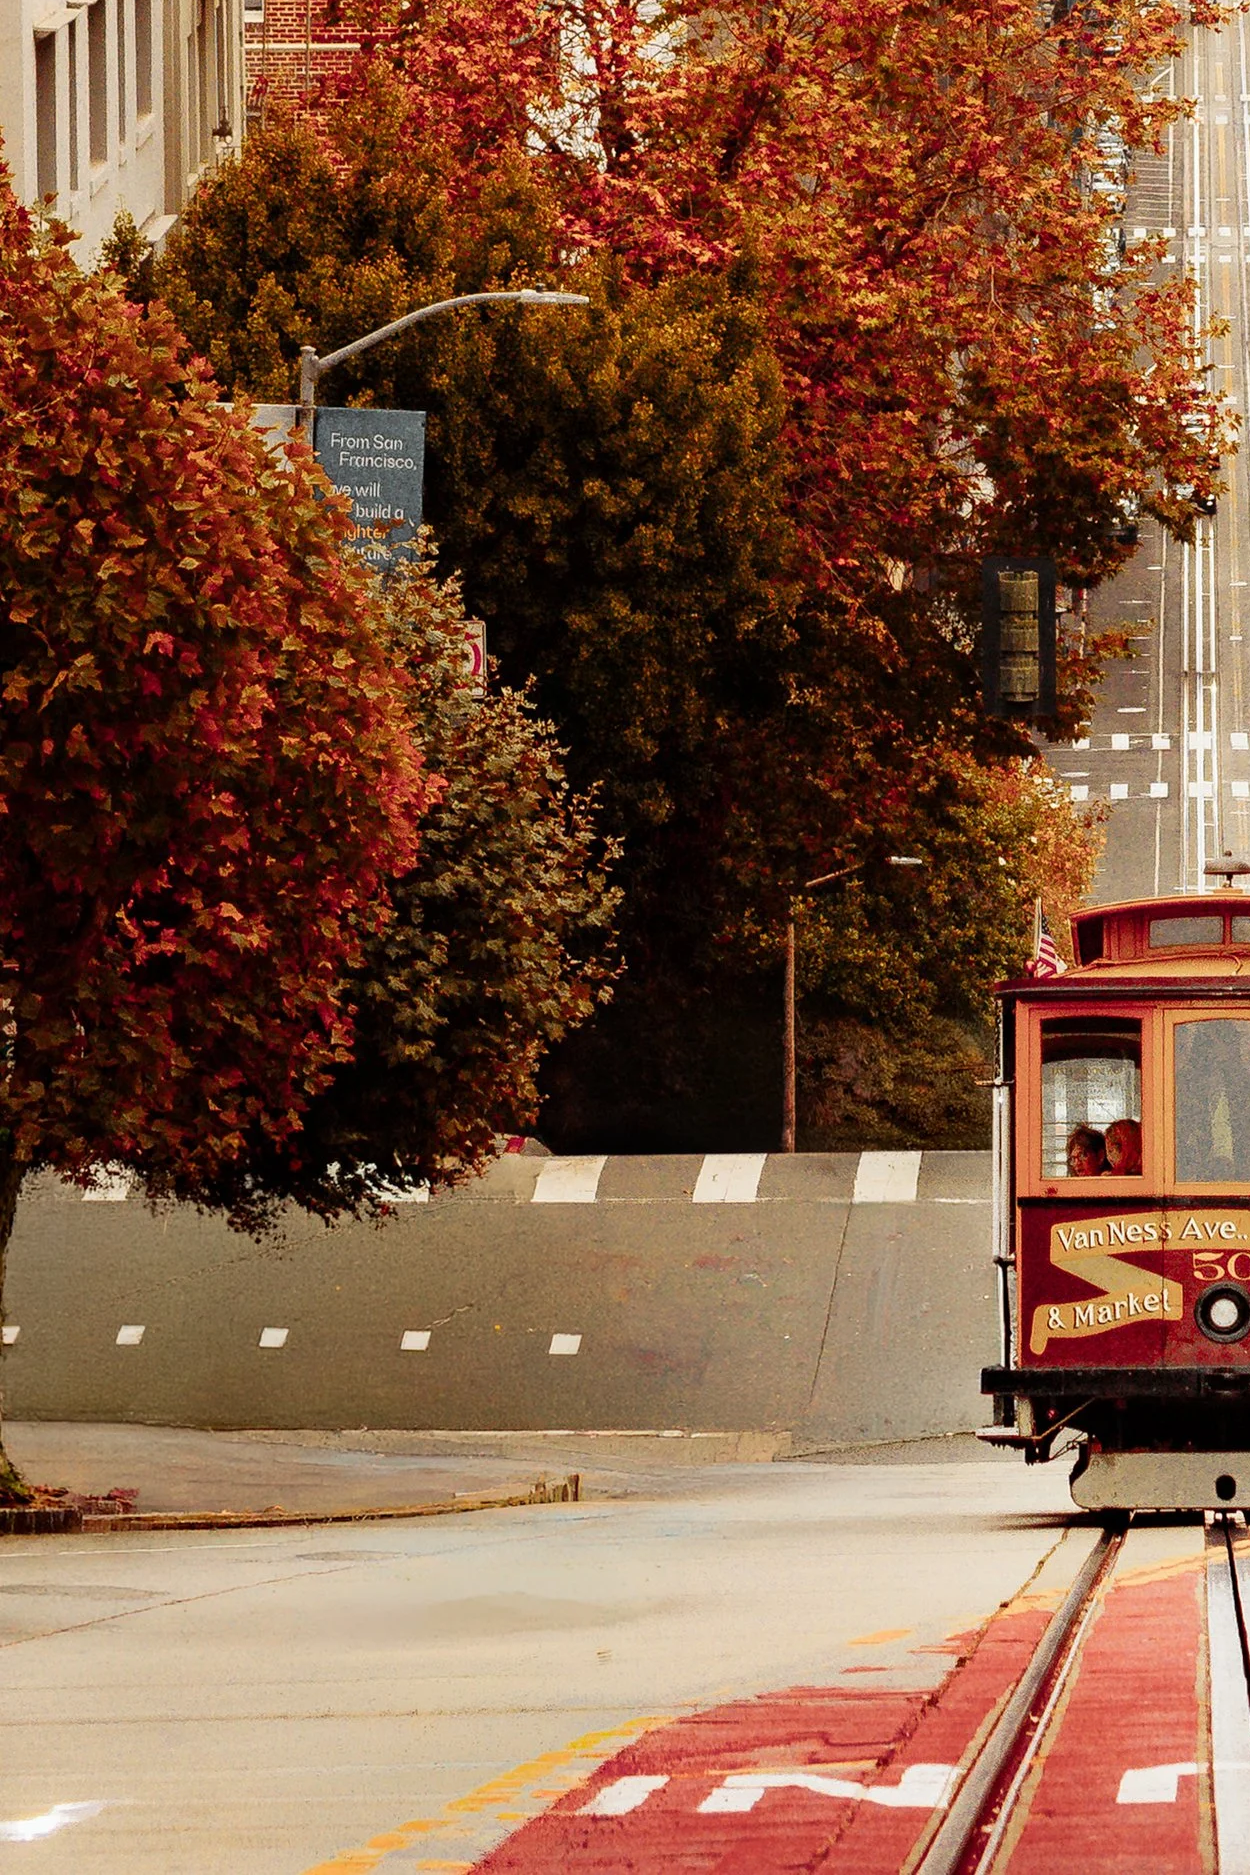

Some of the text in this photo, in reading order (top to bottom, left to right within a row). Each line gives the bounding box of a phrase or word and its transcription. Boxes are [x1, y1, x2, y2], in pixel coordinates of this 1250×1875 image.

[330, 432, 403, 451] From San
[339, 451, 418, 470] Francisco,
[355, 481, 381, 498] will
[356, 503, 405, 520] build a
[1056, 1227, 1104, 1252] Van
[1107, 1220, 1173, 1245] Ness
[1048, 1303, 1065, 1330] &
[1074, 1288, 1172, 1328] Market
